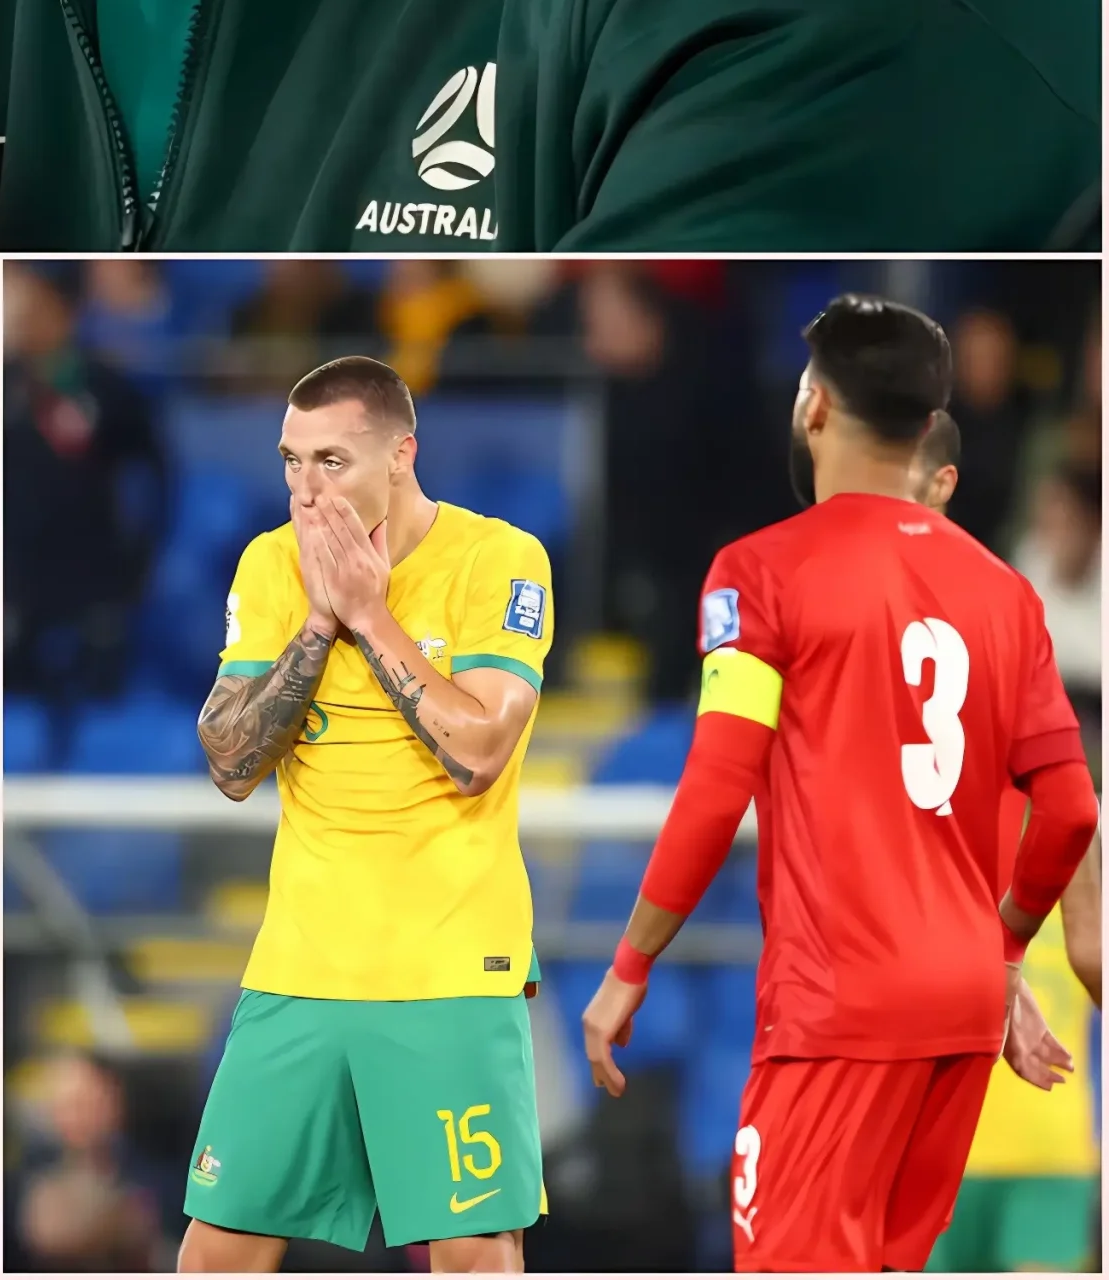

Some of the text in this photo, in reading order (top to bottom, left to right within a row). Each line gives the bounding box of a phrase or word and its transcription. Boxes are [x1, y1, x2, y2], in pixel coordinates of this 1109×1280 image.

[900, 617, 970, 817] 3
[436, 1103, 502, 1182] 15
[734, 1124, 761, 1209] 3
